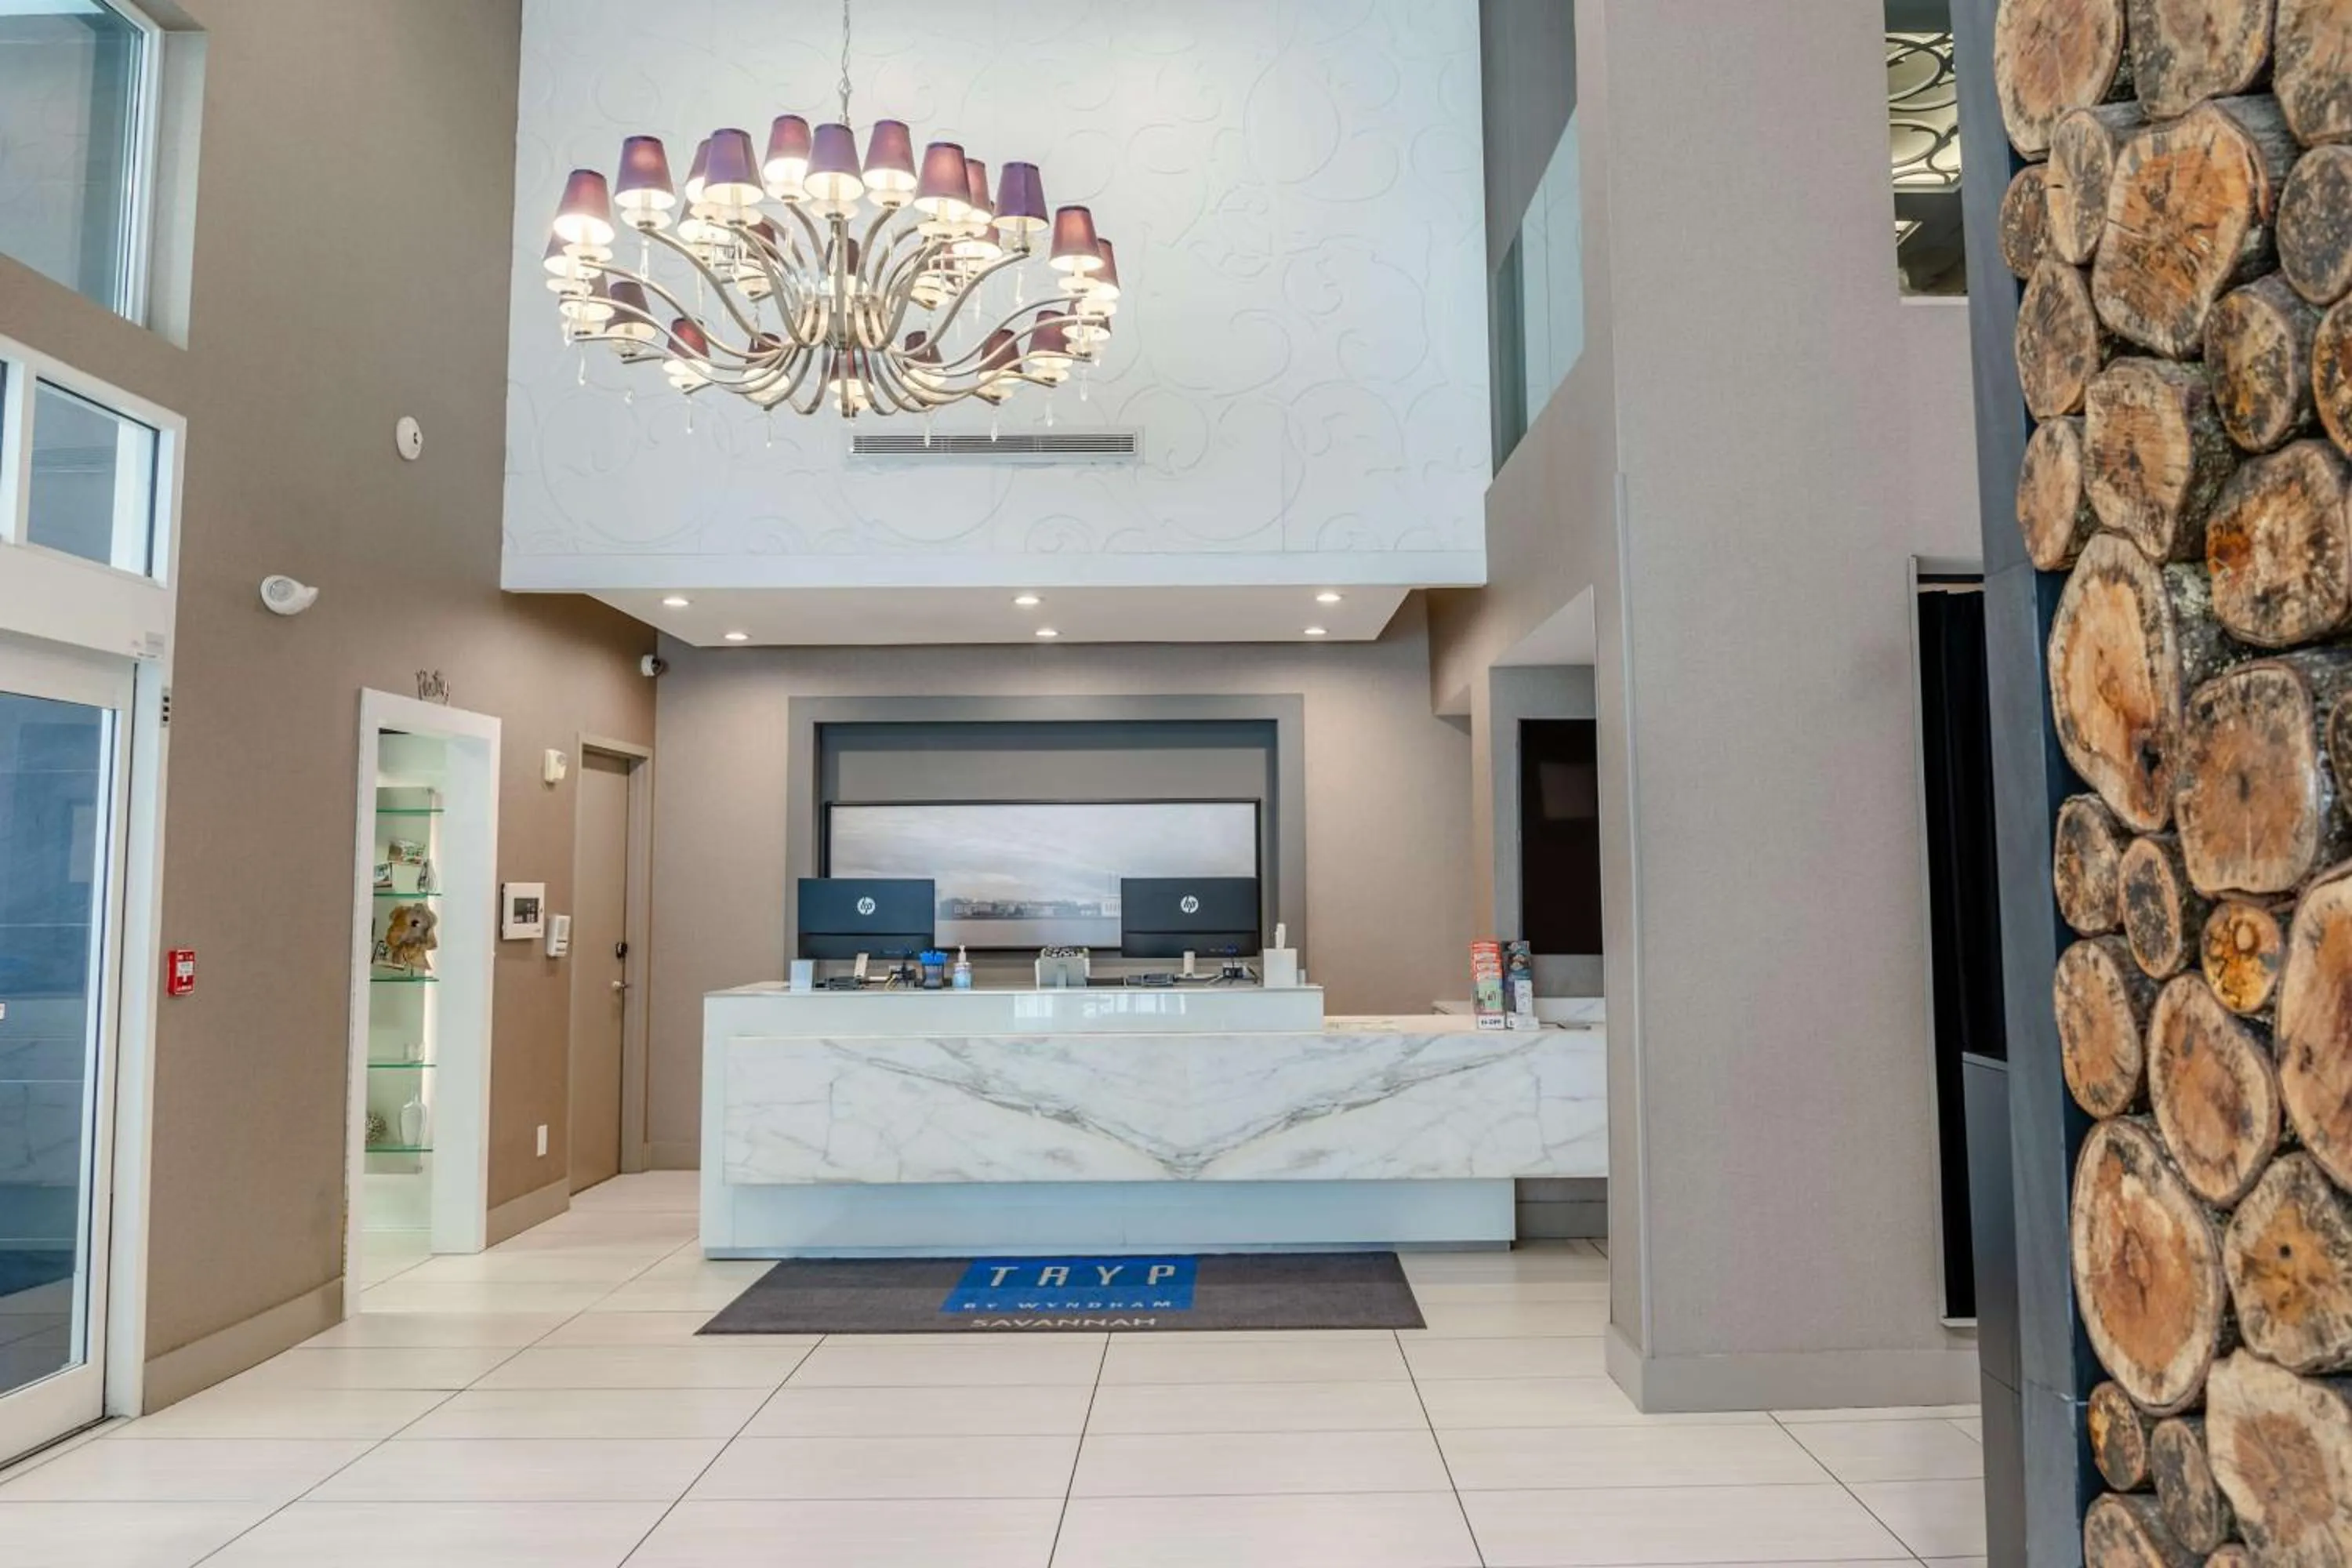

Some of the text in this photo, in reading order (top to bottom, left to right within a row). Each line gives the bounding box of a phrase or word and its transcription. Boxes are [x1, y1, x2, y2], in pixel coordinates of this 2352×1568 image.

[858, 896, 876, 915] hp
[1181, 895, 1198, 913] hp
[1018, 1301, 1171, 1309] WYNDHAM
[970, 1317, 1156, 1327] SAVANNAH
